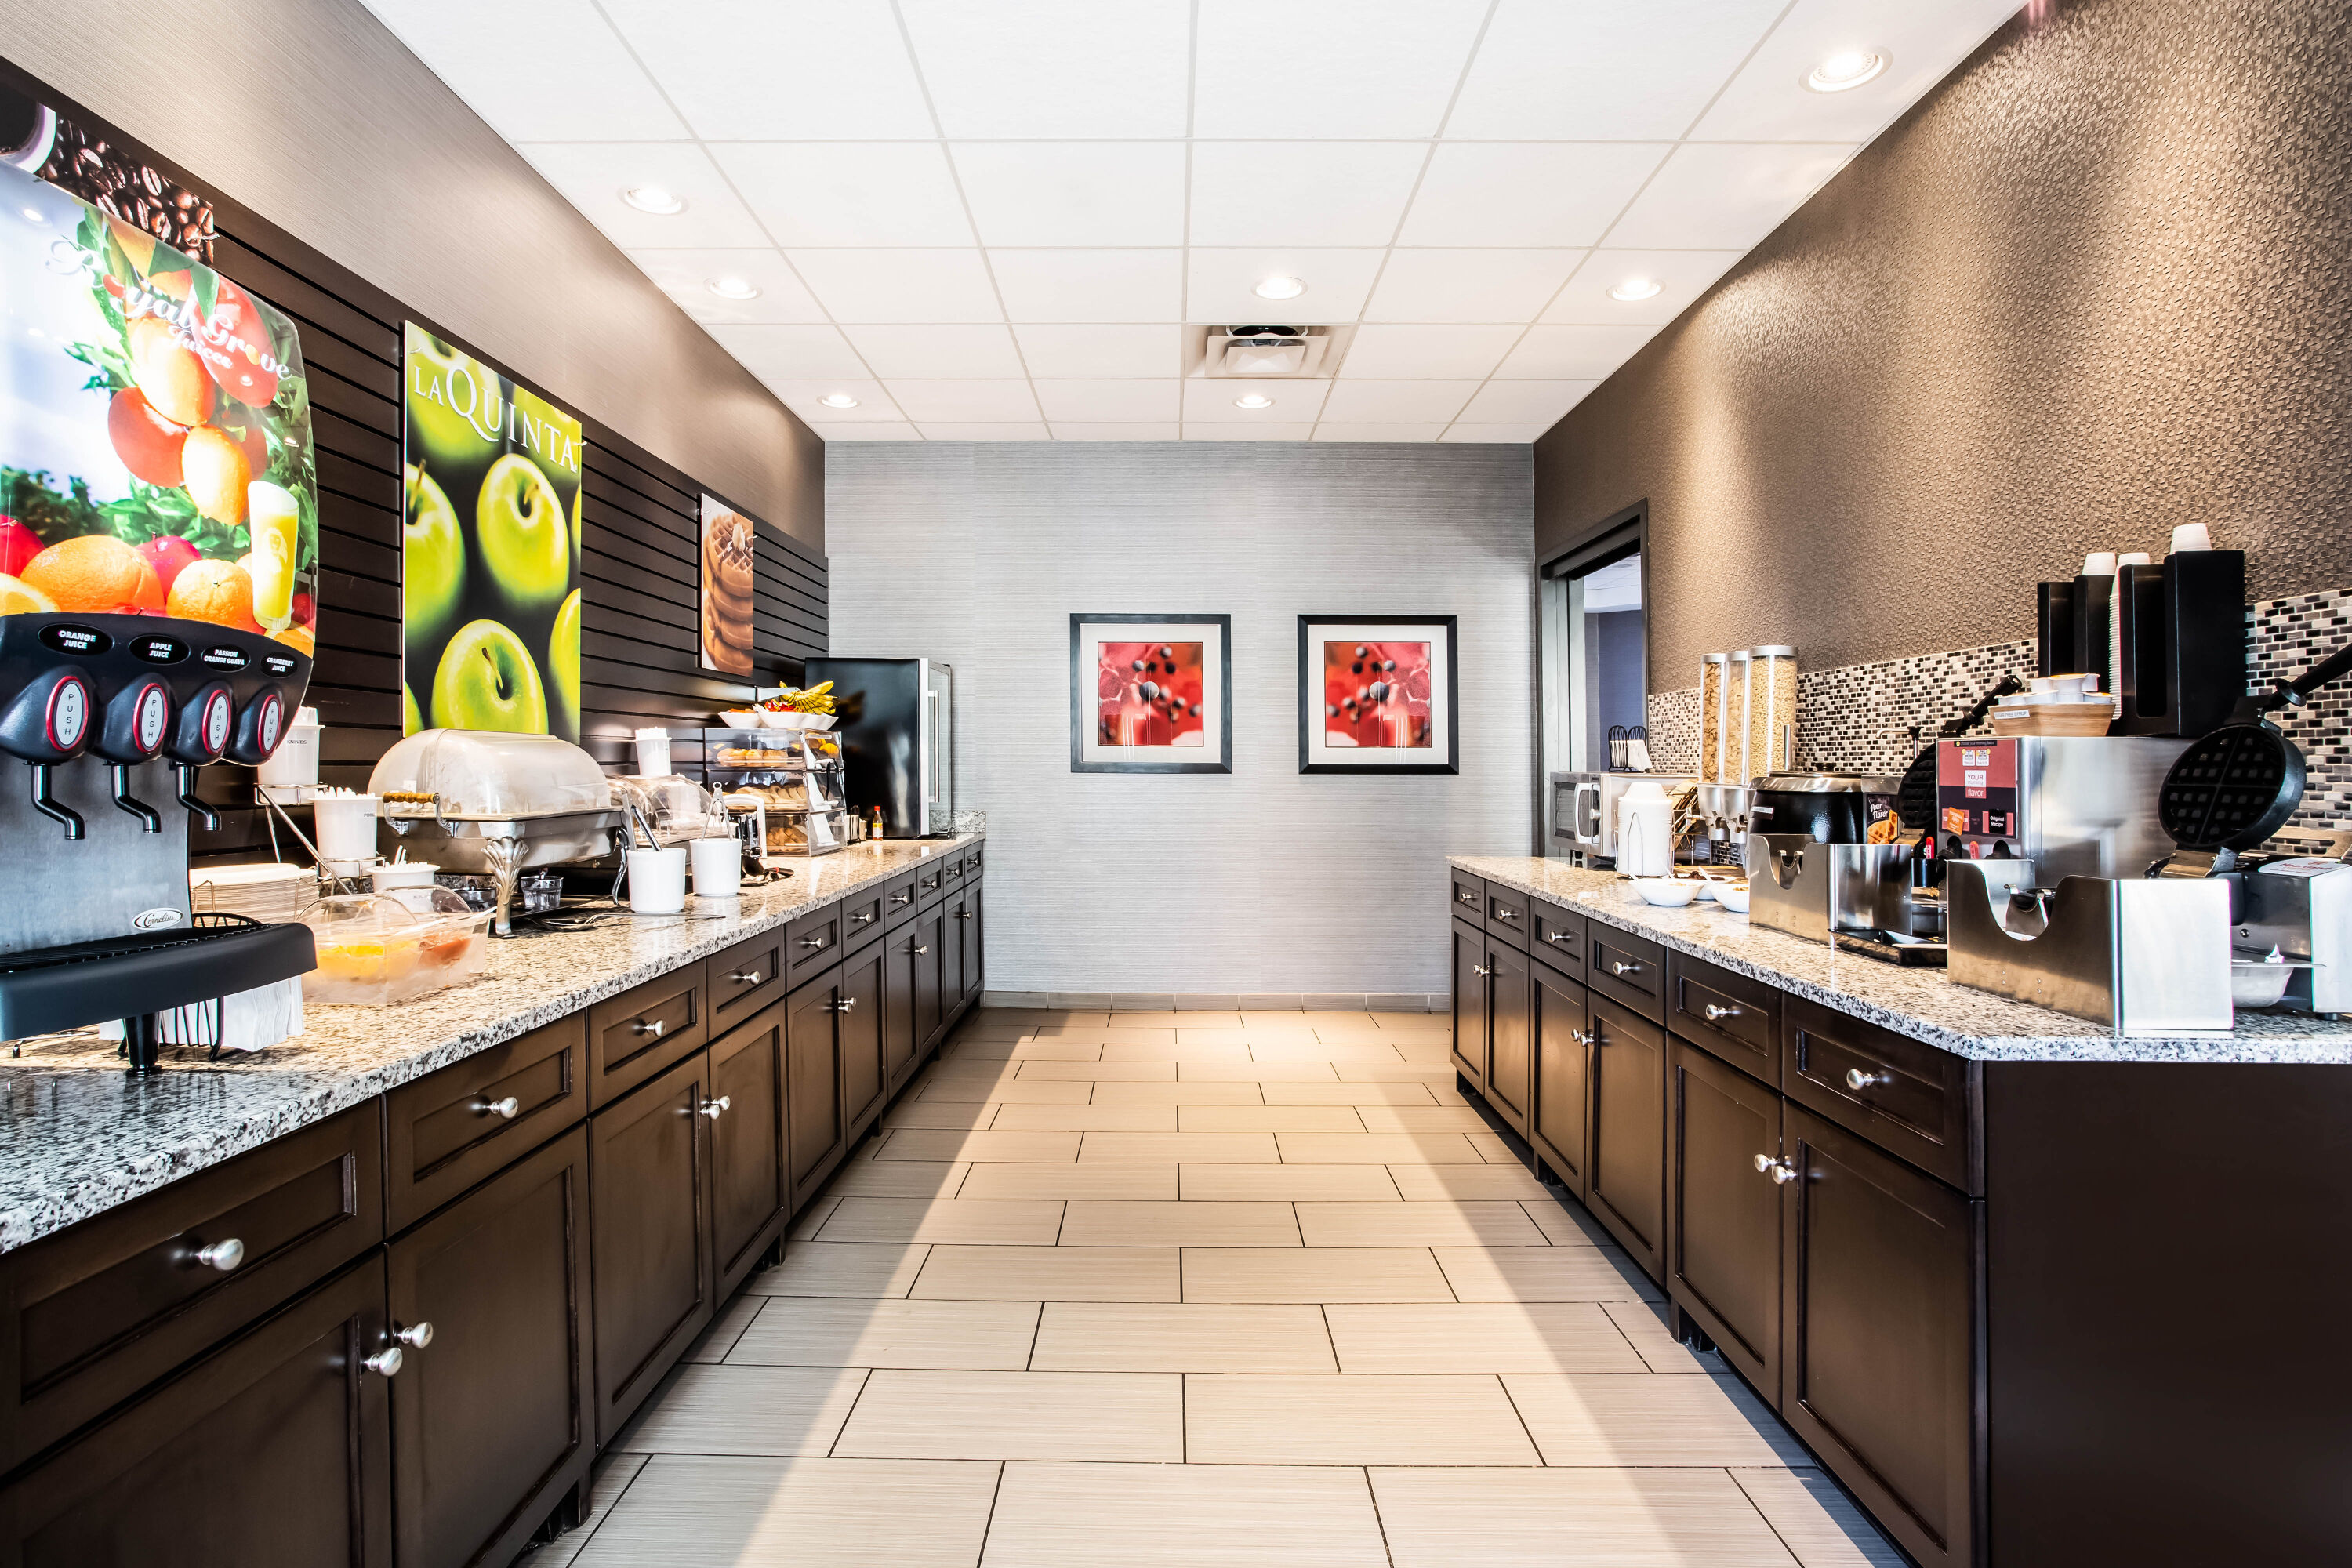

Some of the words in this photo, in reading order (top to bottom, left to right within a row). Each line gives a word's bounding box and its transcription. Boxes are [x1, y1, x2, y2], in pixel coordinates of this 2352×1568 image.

[414, 365, 444, 406] LA
[446, 367, 578, 474] QUINTA
[58, 630, 96, 642] ORANGE
[63, 640, 88, 650] JUICE
[149, 642, 172, 652] APPLE
[149, 650, 169, 659] JUICE
[214, 649, 238, 658] PASSION
[204, 655, 227, 664] ORANGE
[267, 657, 295, 666] CRANBERRY
[64, 694, 74, 735] PUSH
[147, 700, 157, 738] PUSH
[1968, 788, 1984, 797] flavor
[143, 912, 174, 927] Cornelius
